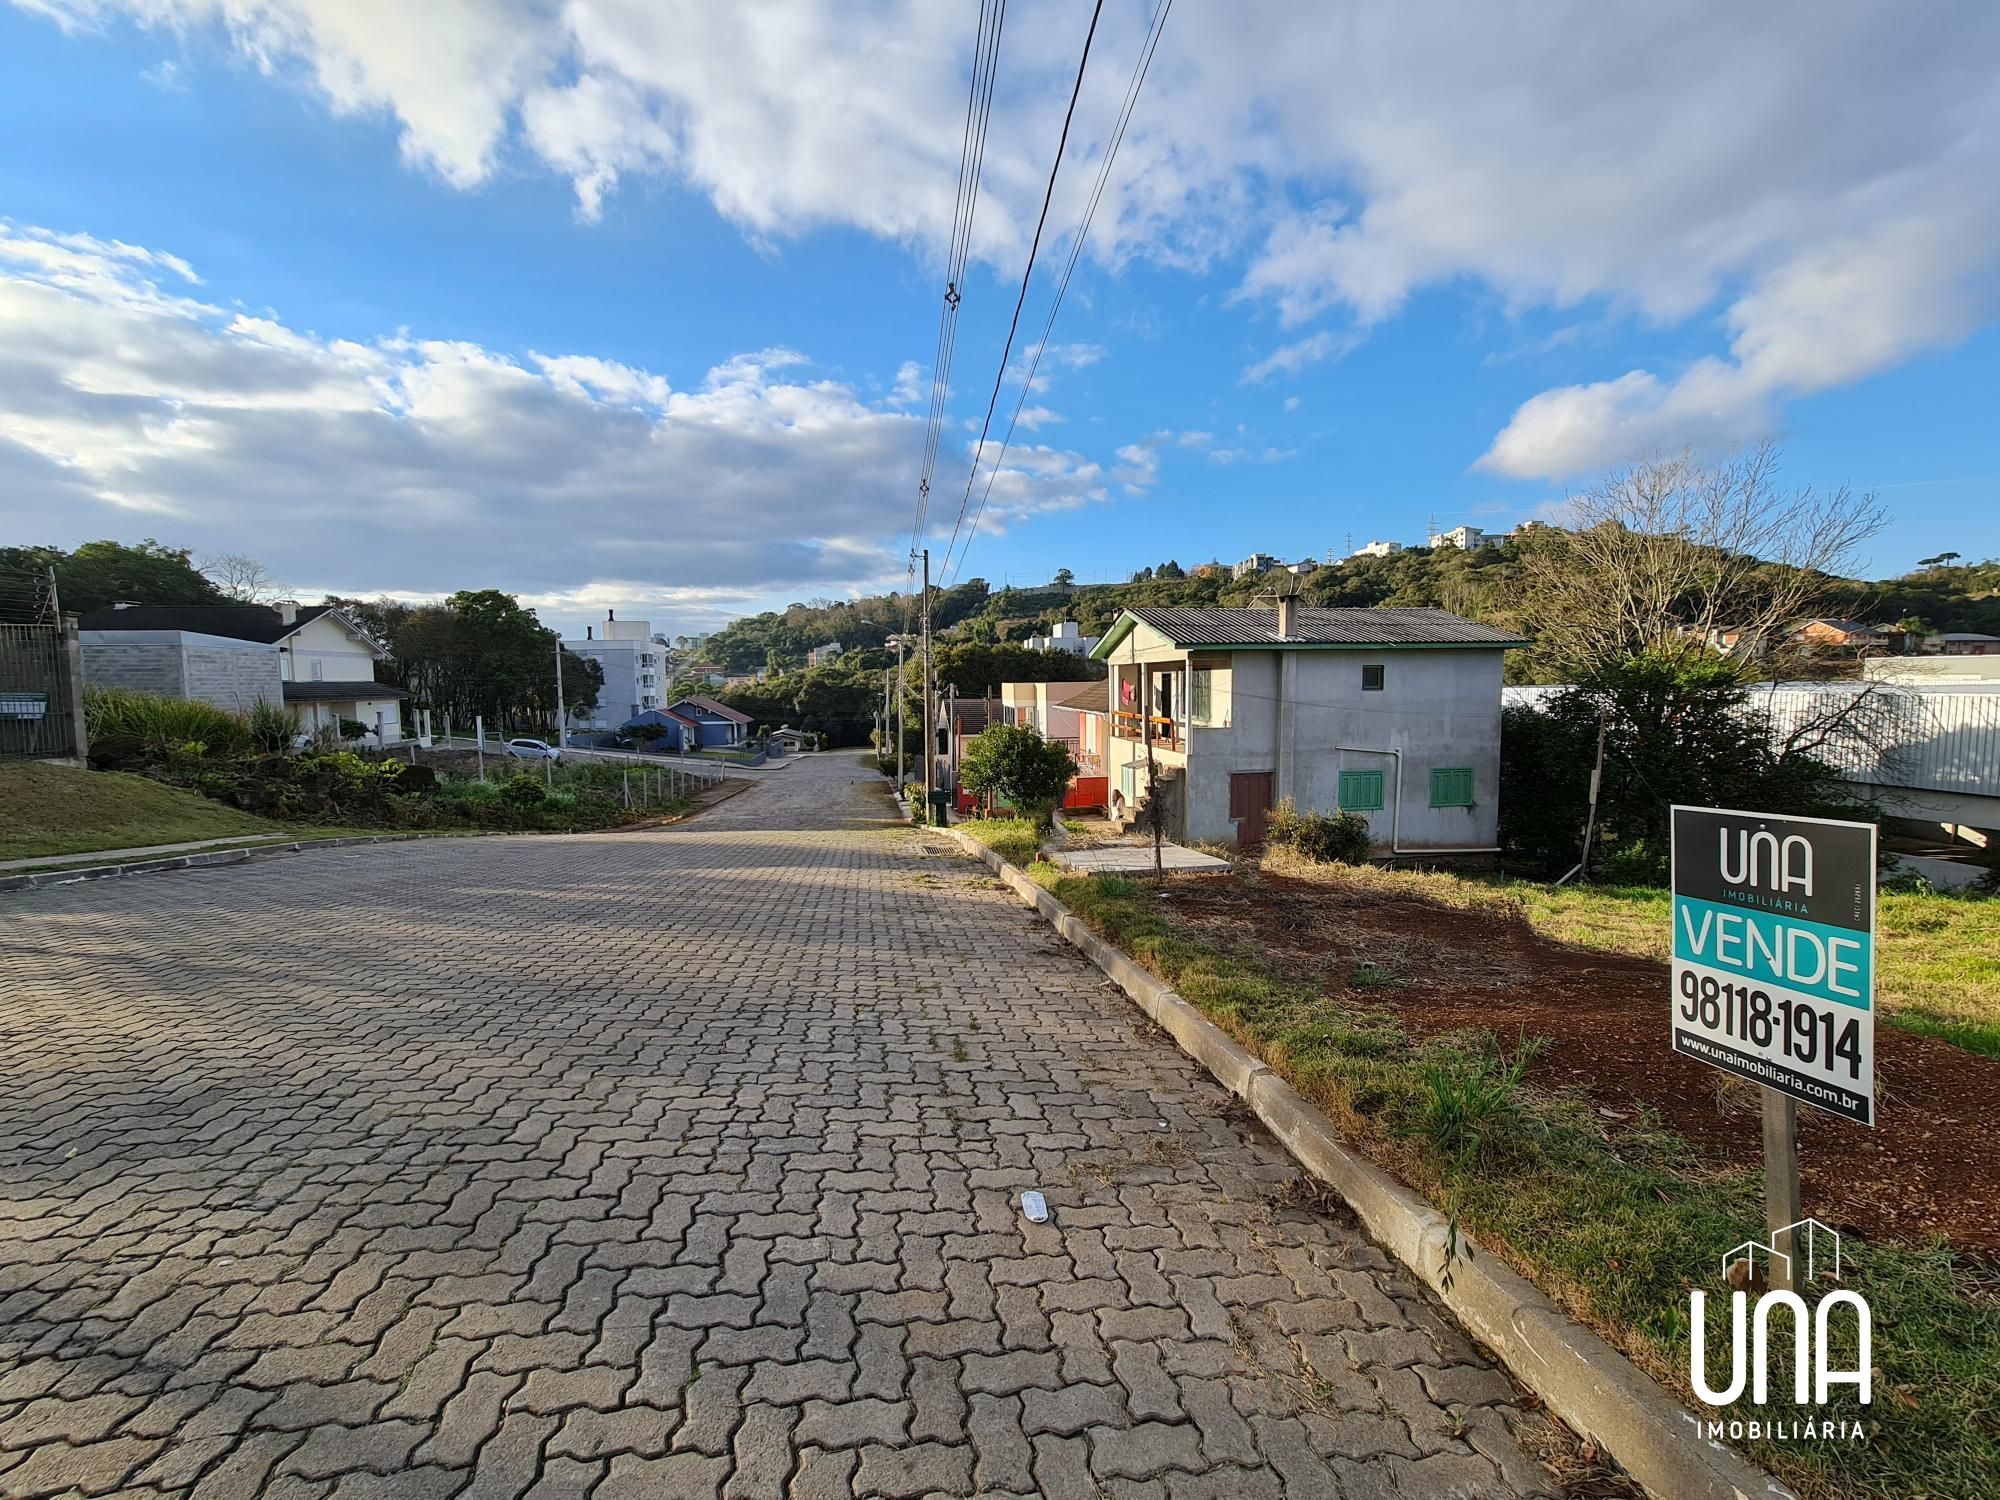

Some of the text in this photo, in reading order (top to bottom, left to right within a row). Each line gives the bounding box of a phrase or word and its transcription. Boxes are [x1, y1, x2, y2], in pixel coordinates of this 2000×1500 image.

[1720, 827, 1813, 897] UNA
[1723, 889, 1809, 914] IMOBILIÁRIA
[1681, 904, 1861, 997] VENDE
[1680, 970, 1862, 1080] 98118-1914
[1681, 1035, 1859, 1111] www.unaimobiliaria.com.br
